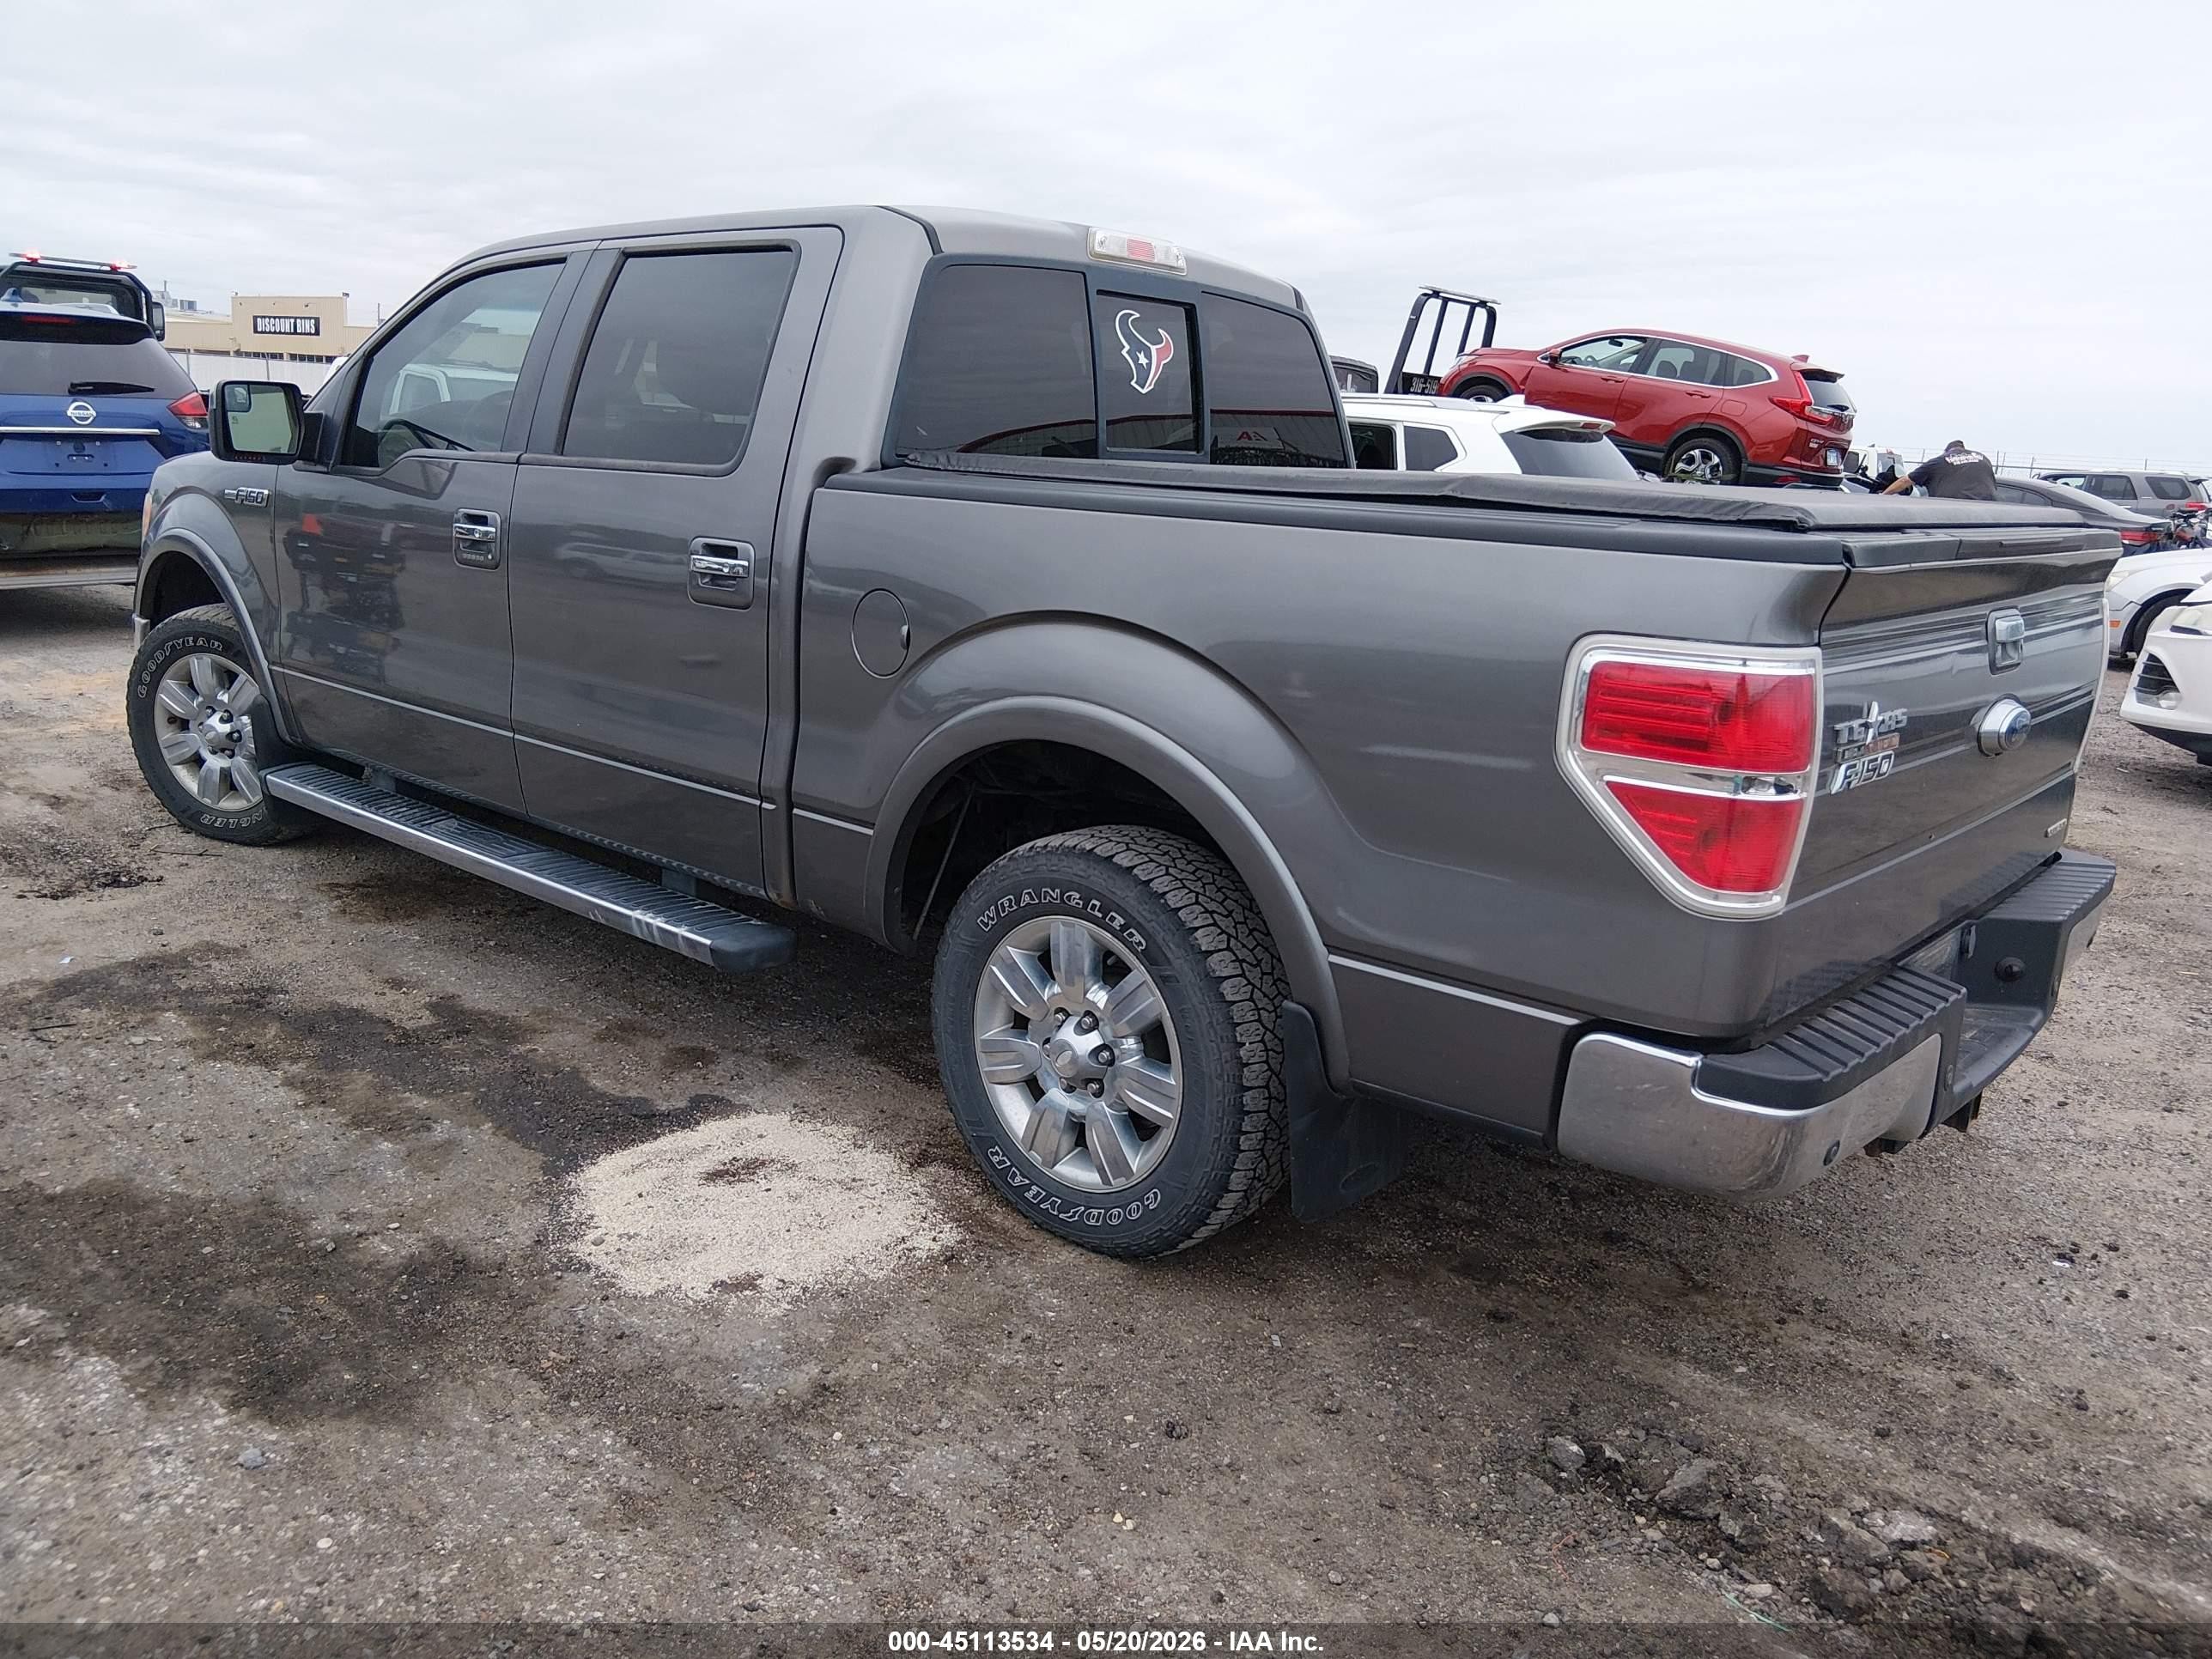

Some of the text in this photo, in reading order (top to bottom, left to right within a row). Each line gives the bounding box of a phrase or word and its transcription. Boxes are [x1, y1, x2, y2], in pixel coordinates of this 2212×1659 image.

[257, 317, 316, 334] DISCOUNT BINS
[138, 637, 223, 698] GOODYEAR
[200, 808, 267, 830] NGLER
[976, 887, 1147, 952] WRANGLER
[988, 1145, 1162, 1226] GOODYEAR
